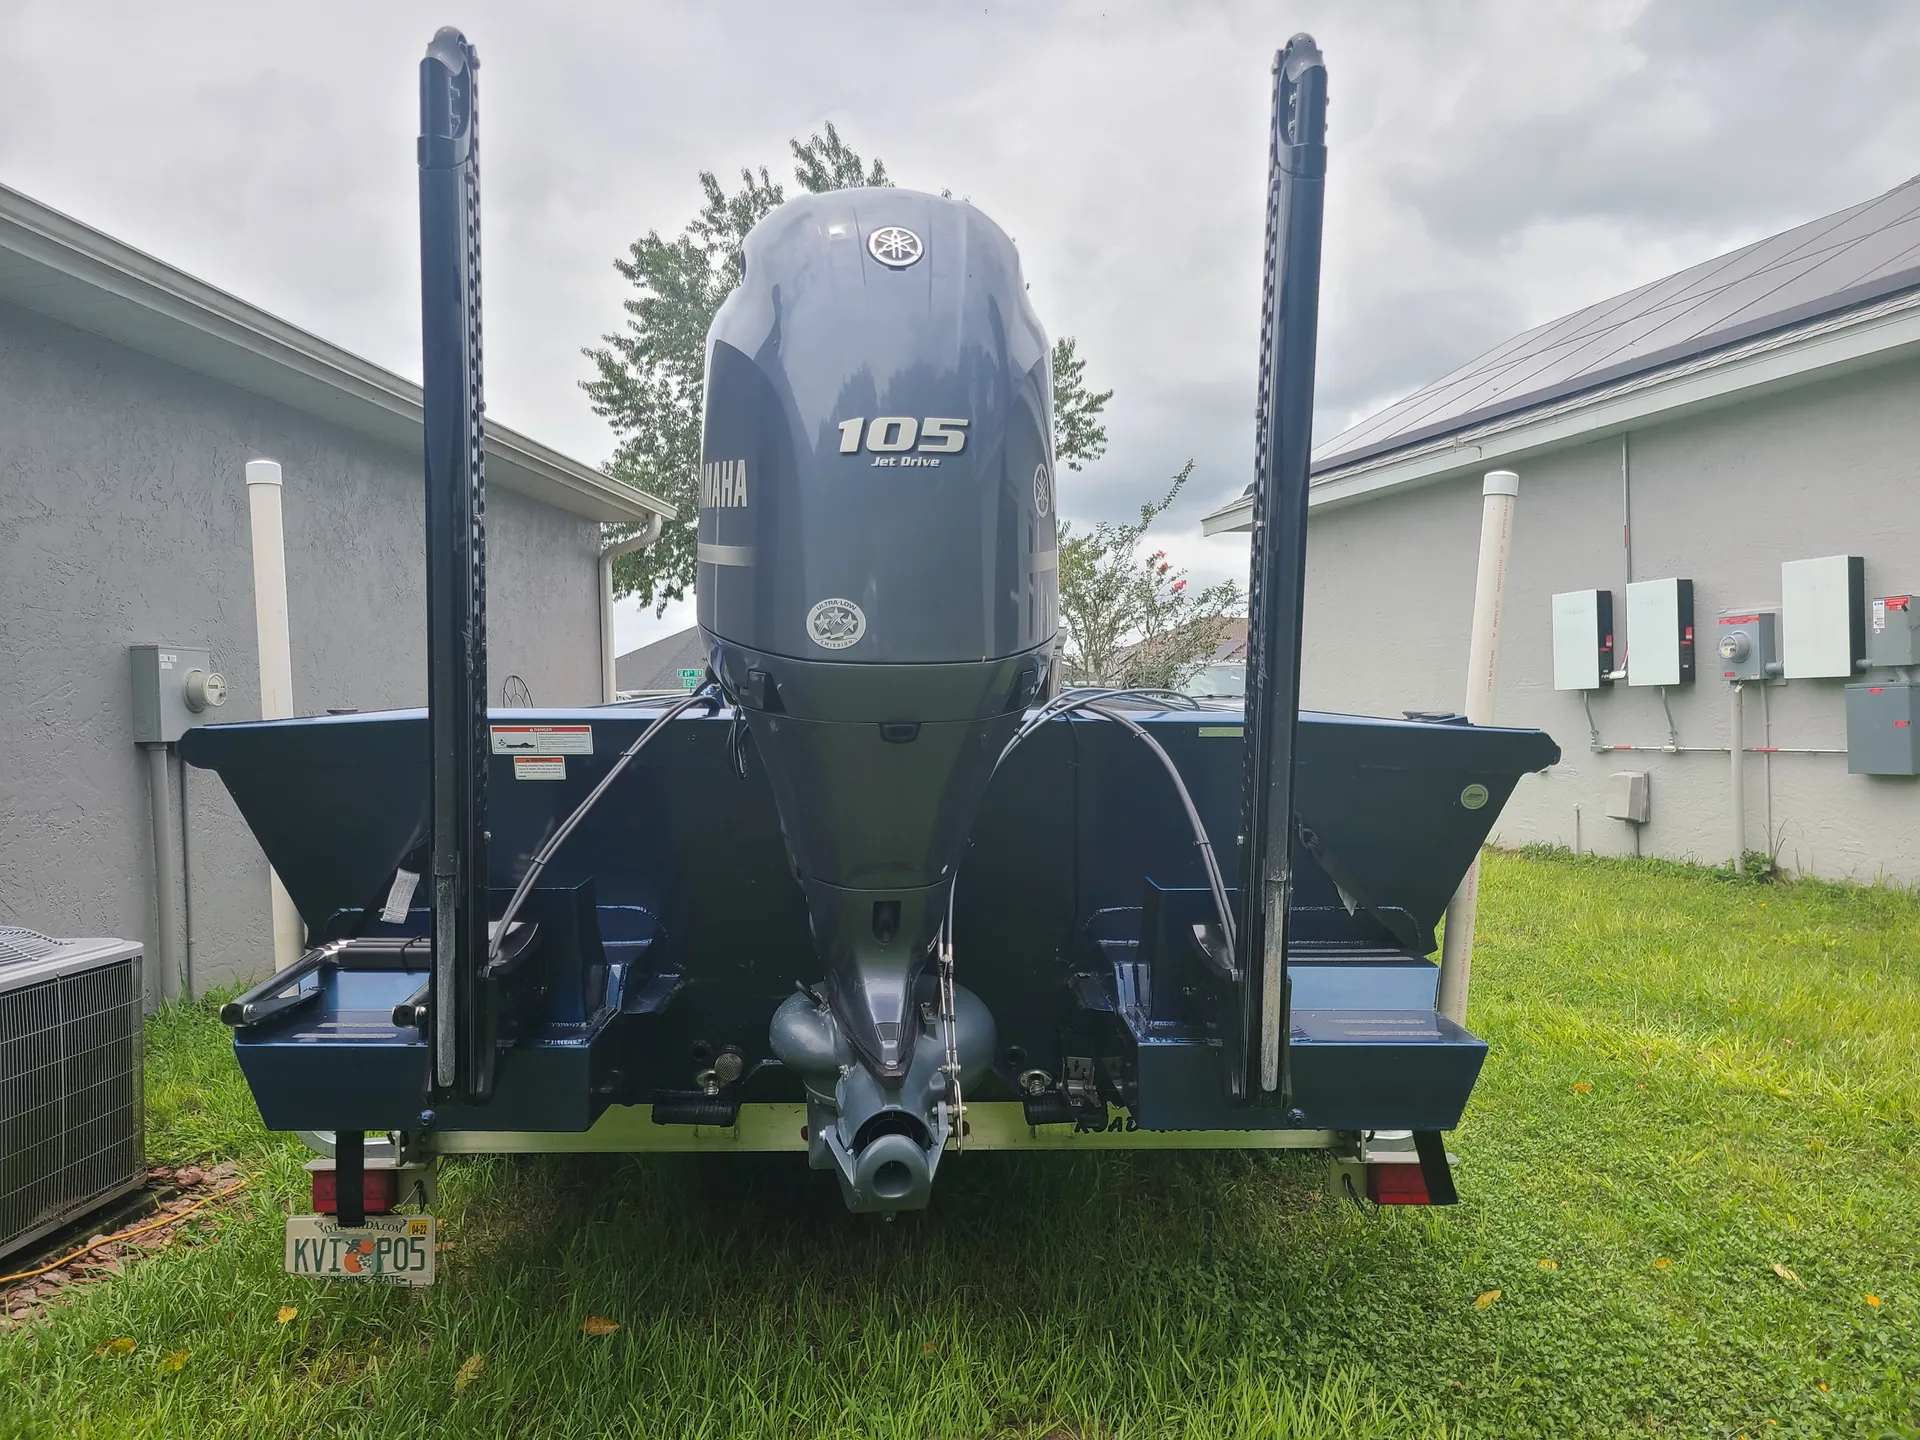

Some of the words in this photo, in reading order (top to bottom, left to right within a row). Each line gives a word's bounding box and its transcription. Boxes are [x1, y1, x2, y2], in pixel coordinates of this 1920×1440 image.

[838, 417, 969, 453] 105
[871, 456, 896, 467] Jet
[901, 456, 940, 467] Drive
[816, 600, 857, 611] ULTRA-LOW
[820, 640, 853, 648] EMISSION
[294, 1237, 342, 1273] KVI
